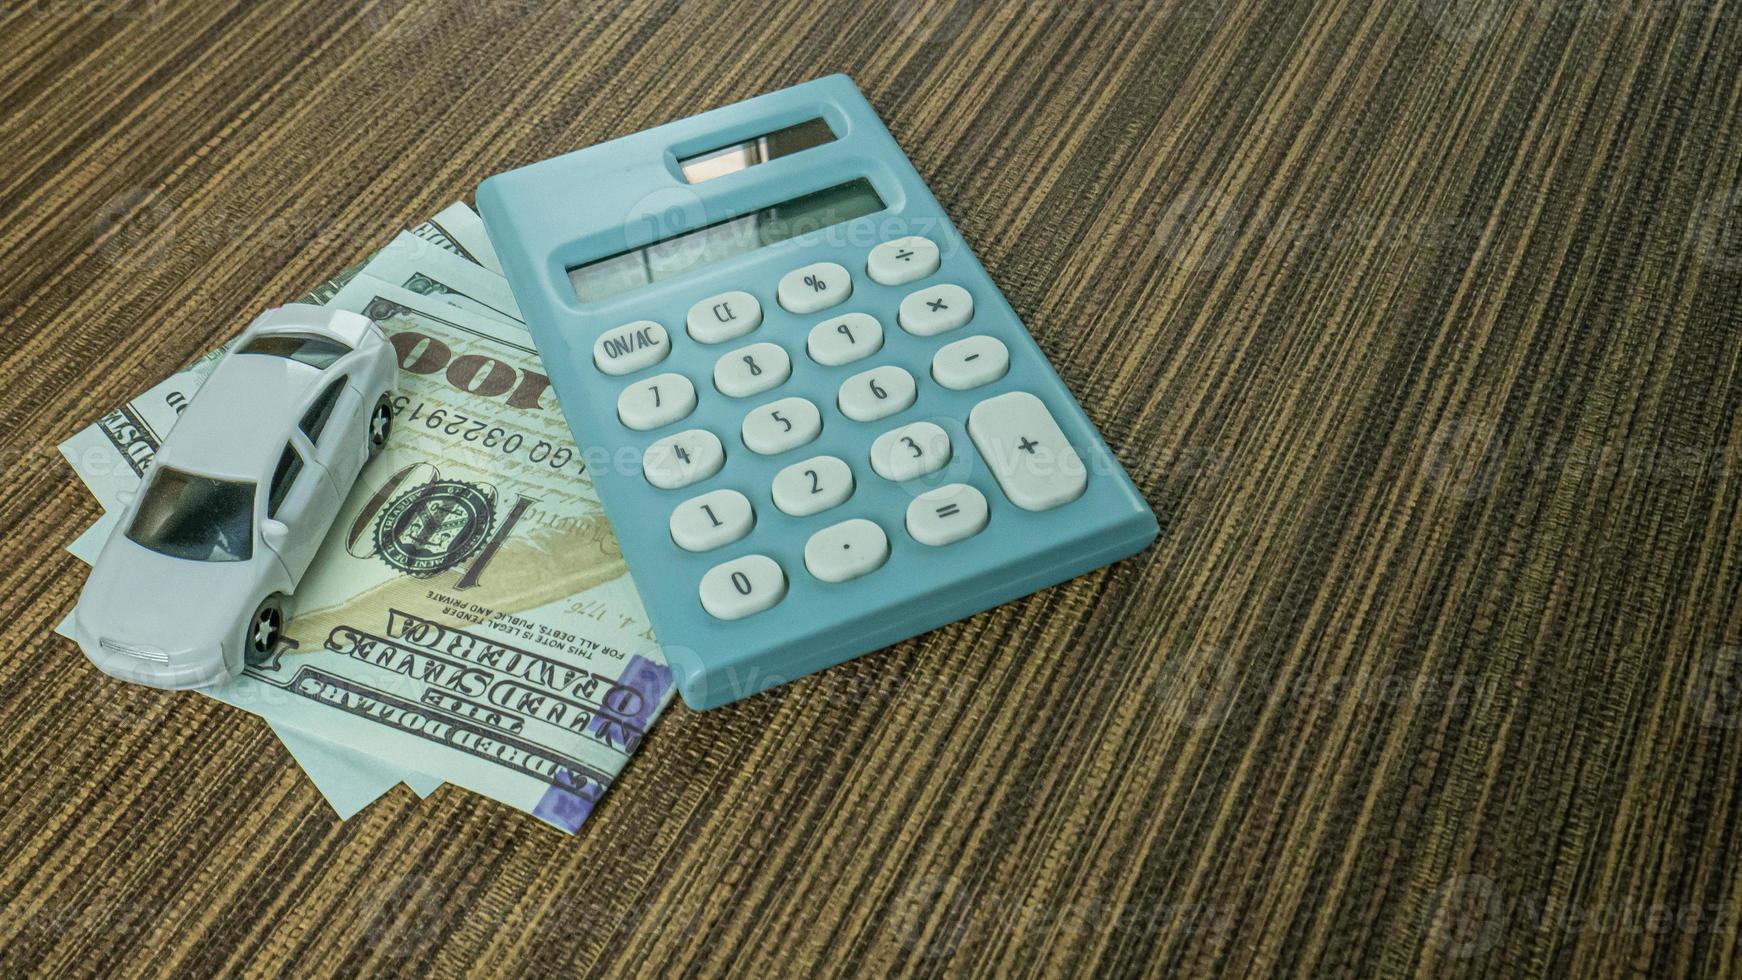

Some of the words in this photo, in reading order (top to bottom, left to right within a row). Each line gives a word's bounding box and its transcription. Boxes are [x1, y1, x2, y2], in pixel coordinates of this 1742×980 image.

[713, 302, 737, 324] CE
[603, 326, 661, 360] ON/AC
[837, 324, 857, 345] 9
[389, 332, 551, 410] 100
[743, 355, 763, 377] 8
[650, 386, 664, 409] 7
[869, 379, 889, 401] 6
[772, 410, 793, 433] 5
[673, 444, 692, 465] 4
[901, 436, 924, 459] 3
[804, 469, 824, 495] 2
[701, 504, 724, 528] 1
[731, 571, 754, 598] 0
[425, 590, 468, 610] PRIVATE
[470, 603, 493, 617] AND
[442, 606, 484, 626] TENDER
[487, 618, 520, 636] LEGAL
[494, 612, 537, 631] PUBLIC
[521, 629, 533, 641] IS
[535, 633, 565, 651] NOTE
[579, 637, 601, 652] ALL
[324, 625, 495, 697] STATES
[387, 608, 590, 693] AMERICA
[568, 643, 594, 661] THIS
[601, 645, 626, 661] FOR
[300, 676, 451, 744] DOLLARS
[421, 687, 526, 736] THE
